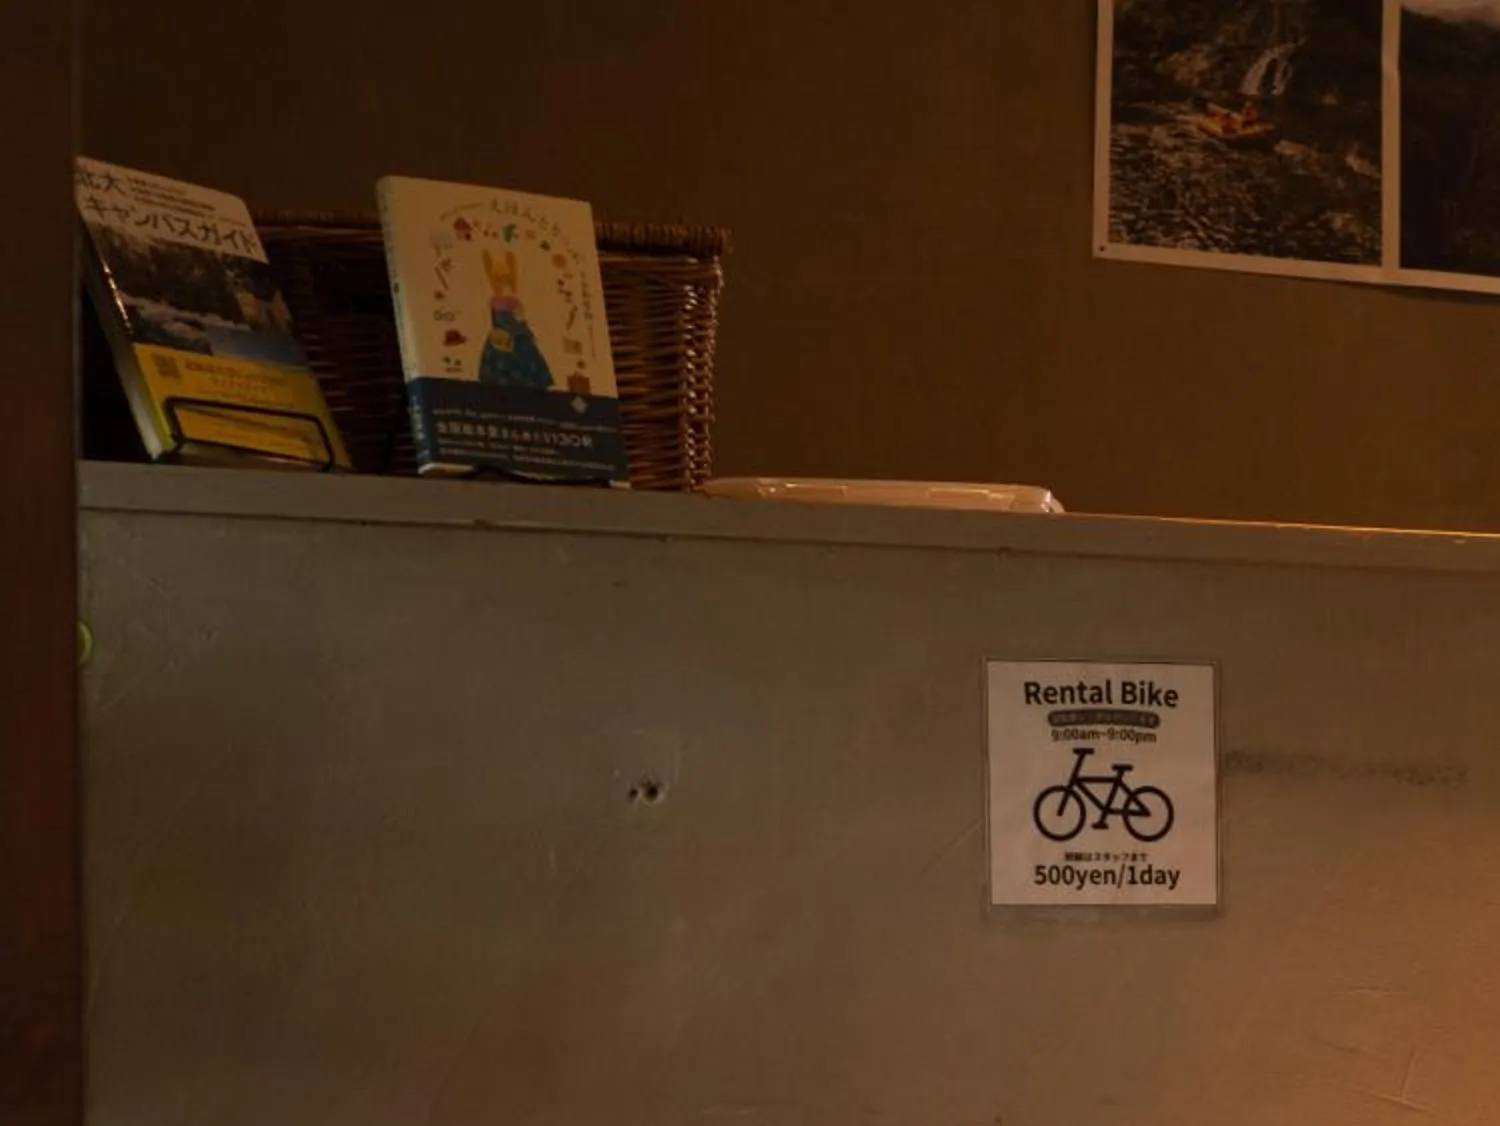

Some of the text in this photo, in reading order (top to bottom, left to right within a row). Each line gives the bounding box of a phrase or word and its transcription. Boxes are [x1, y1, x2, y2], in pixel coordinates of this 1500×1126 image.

[1024, 680, 1179, 708] Rental Bike
[1033, 863, 1181, 891] 500yen/1day
